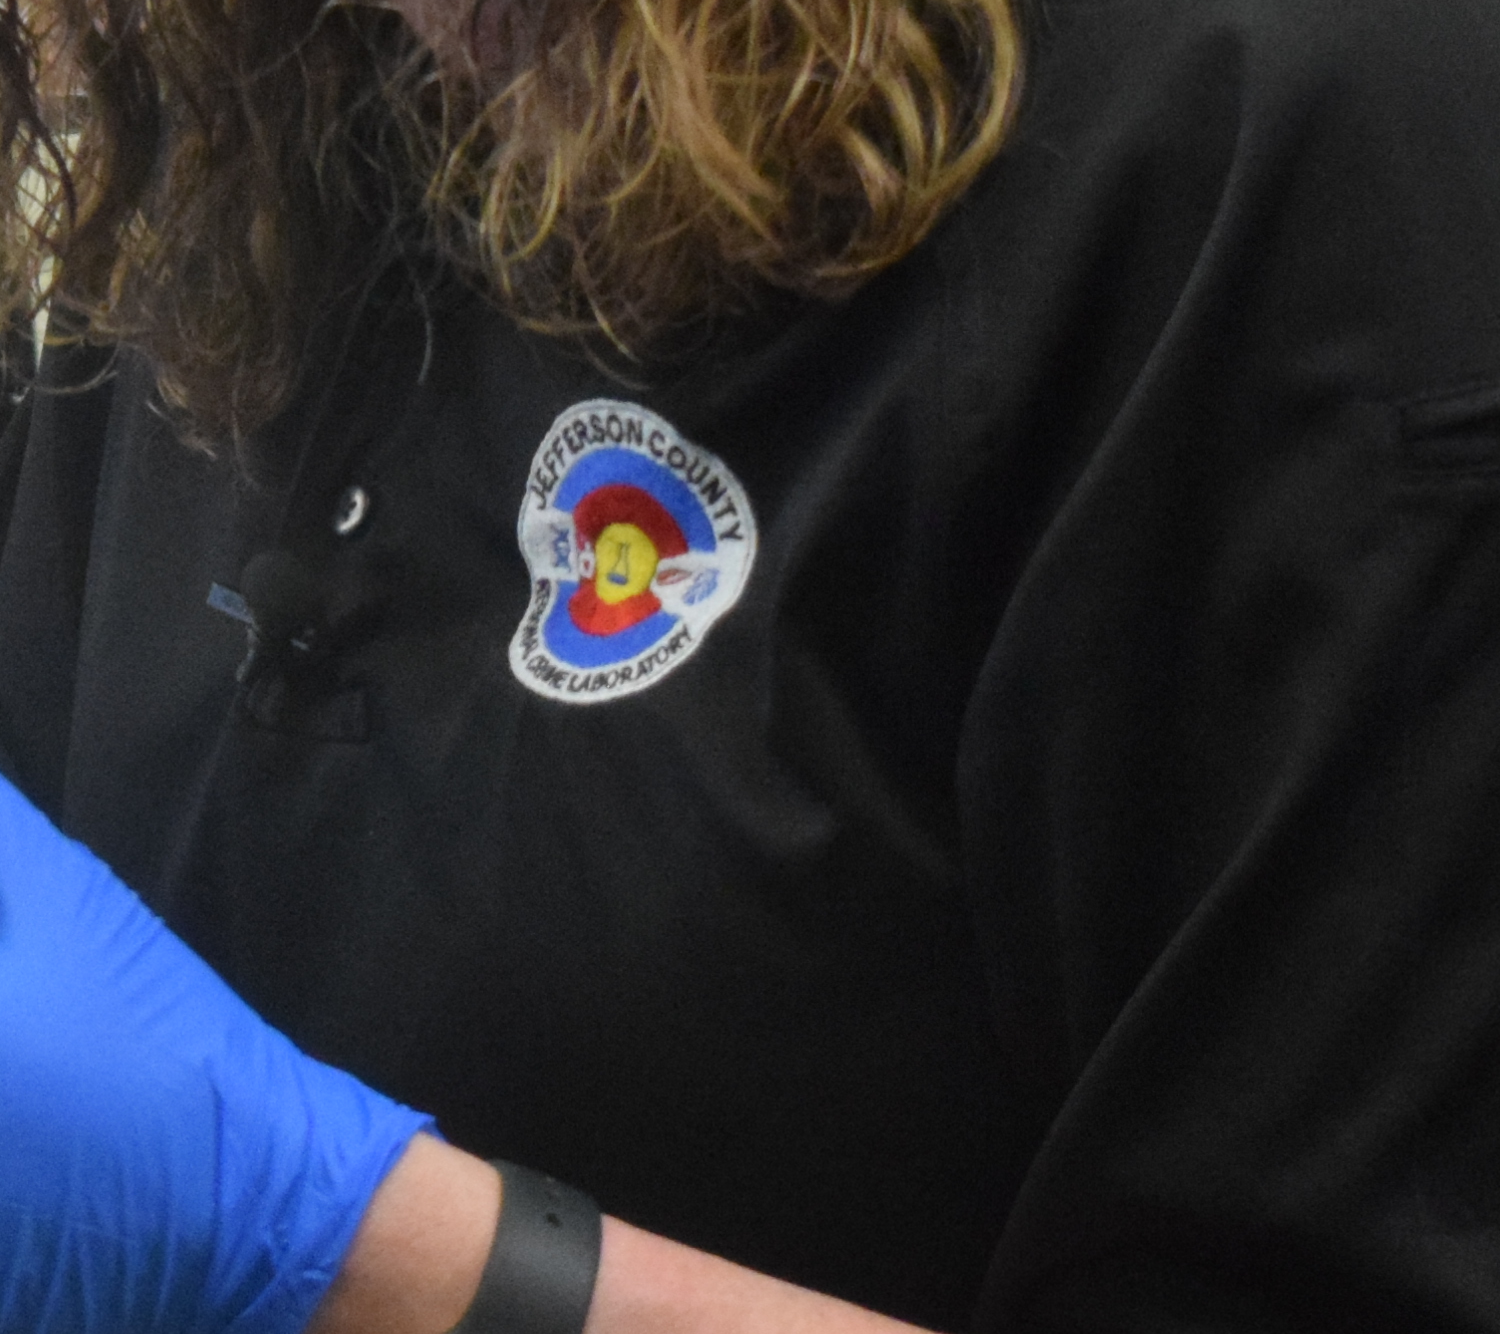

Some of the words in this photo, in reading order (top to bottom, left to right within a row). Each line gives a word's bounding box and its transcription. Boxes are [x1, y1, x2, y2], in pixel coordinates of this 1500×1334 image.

[530, 414, 643, 511] JEFFERSON
[648, 430, 743, 542] COUNTY
[526, 656, 569, 690] CRIME
[567, 623, 693, 693] LABORATORY
